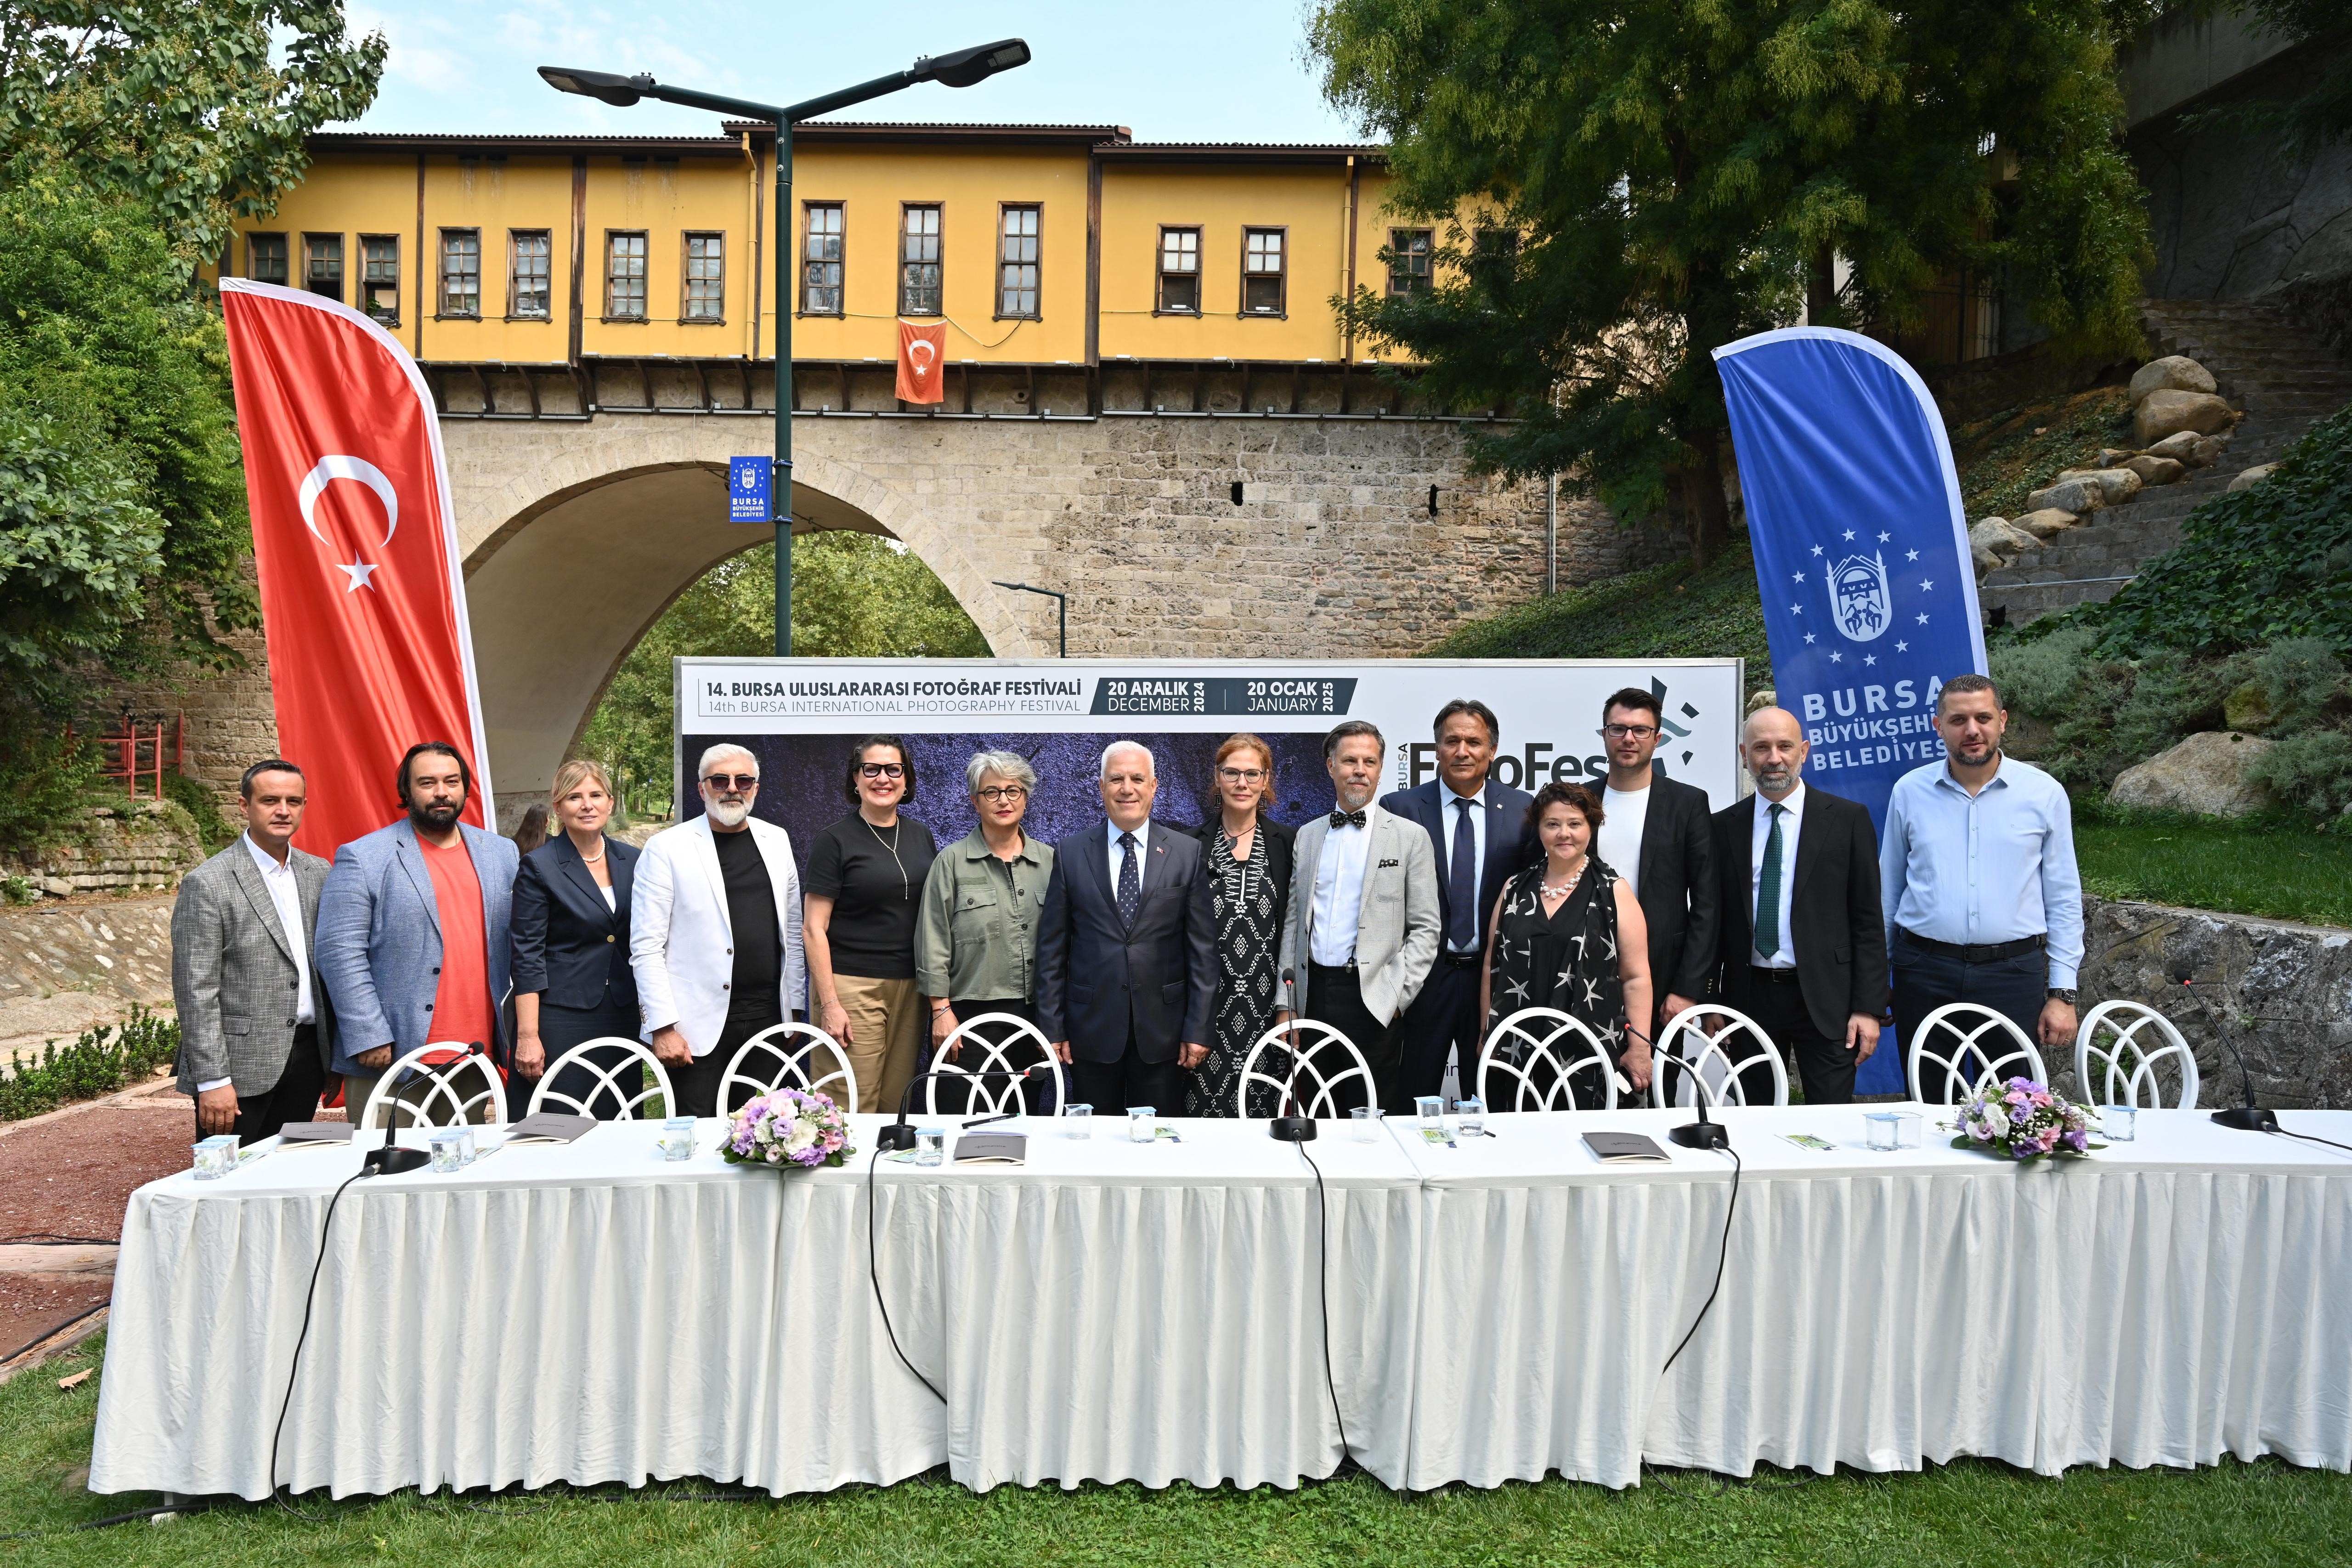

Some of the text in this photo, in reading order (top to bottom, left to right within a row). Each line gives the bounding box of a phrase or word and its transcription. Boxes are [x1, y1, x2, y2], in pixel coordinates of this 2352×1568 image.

[707, 678, 1081, 696] 14. BURSA ULUSLARARASI FOTOĞRAF FESTİVALİ
[1108, 681, 1189, 696] 20 ARALIK
[1193, 682, 1204, 712] 2024
[1247, 681, 1317, 696] 20 OCAK
[1323, 682, 1333, 712] 2025
[1803, 675, 1943, 721] BURSA
[709, 700, 1080, 713] 14th BURSA INTERNATIONAL PHOTOGRAPHY FESTIVAL
[1108, 697, 1189, 711] DECEMBER
[1247, 698, 1318, 711] JANUARY
[1809, 707, 1937, 746] BÜYÜKŞEHİ
[1398, 743, 1408, 790] BURSA
[1410, 742, 1610, 790] FoFes
[1813, 738, 1948, 771] BELEDİYES
